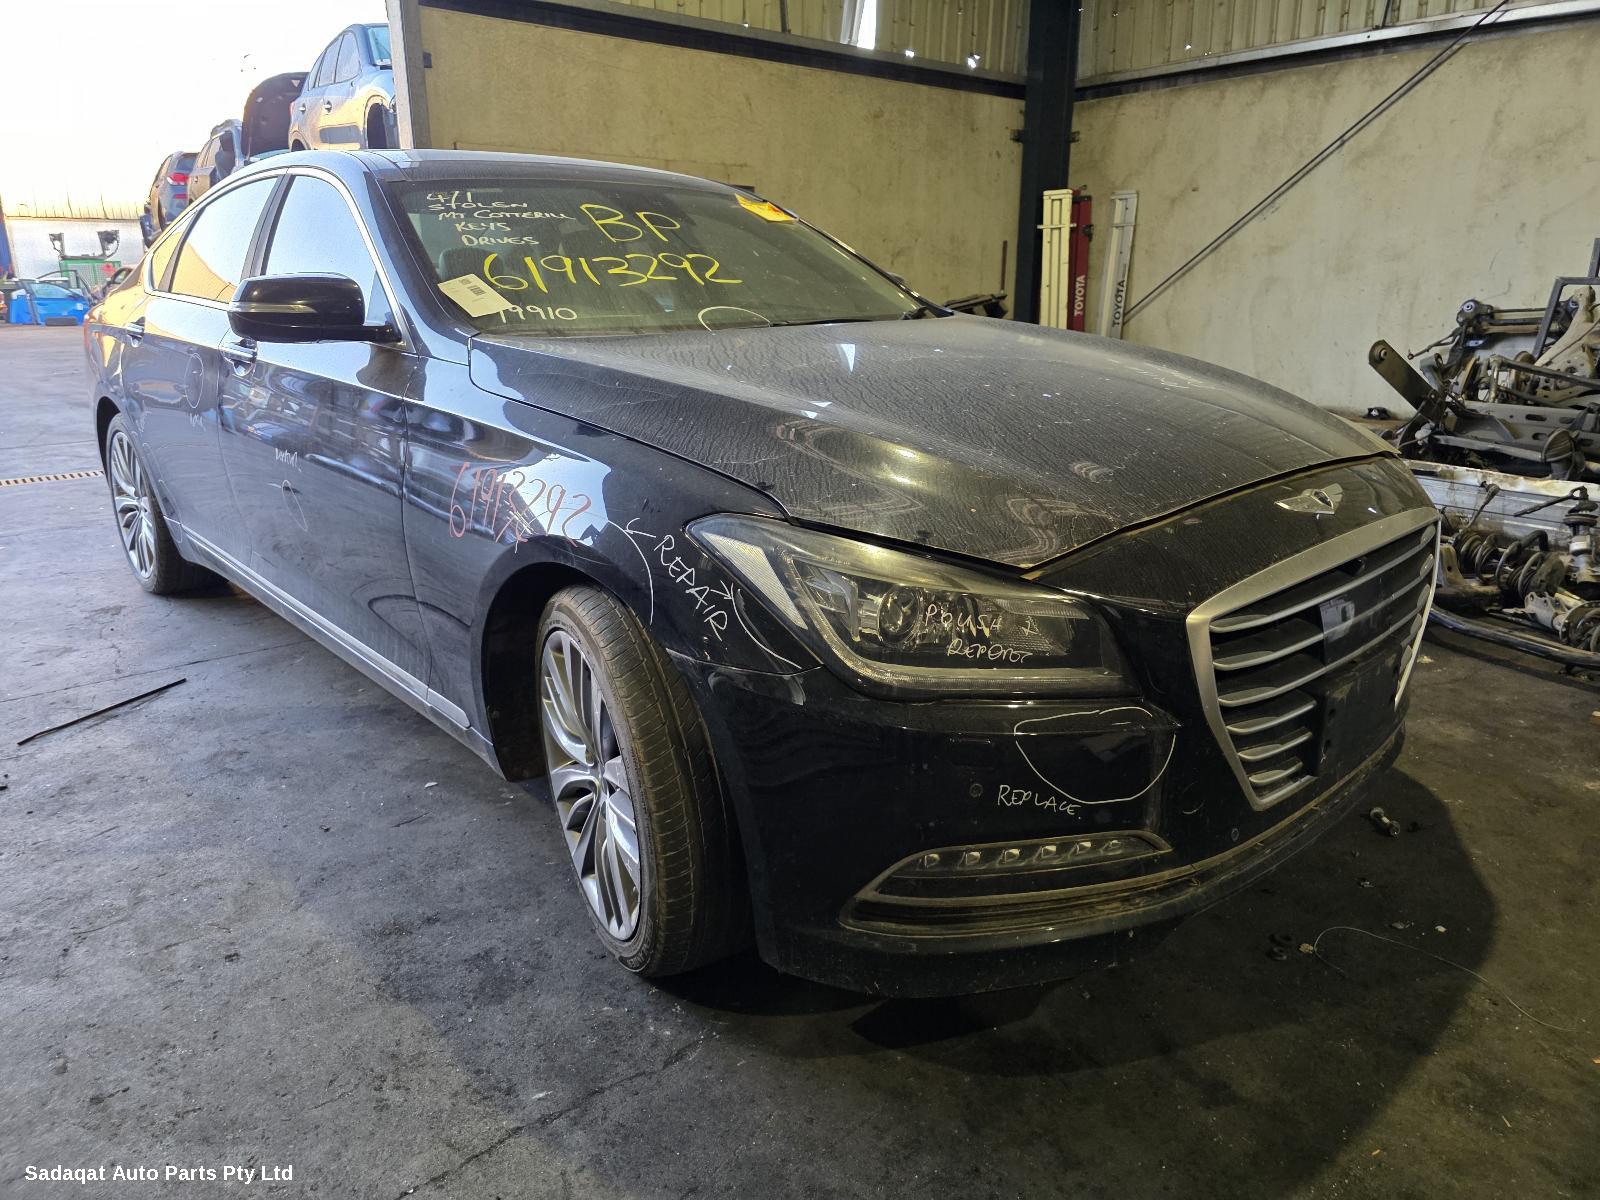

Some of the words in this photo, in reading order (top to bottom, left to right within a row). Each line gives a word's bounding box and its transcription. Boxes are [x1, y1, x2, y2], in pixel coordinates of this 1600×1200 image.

[428, 201, 528, 211] STOLEN
[580, 203, 681, 242] BP
[454, 221, 512, 232] KEYS
[461, 234, 540, 247] DRIVES
[484, 252, 743, 294] 61913292
[1073, 274, 1087, 317] TOYOTA
[1111, 279, 1126, 328] TOYOTA
[653, 534, 728, 642] REPAIR
